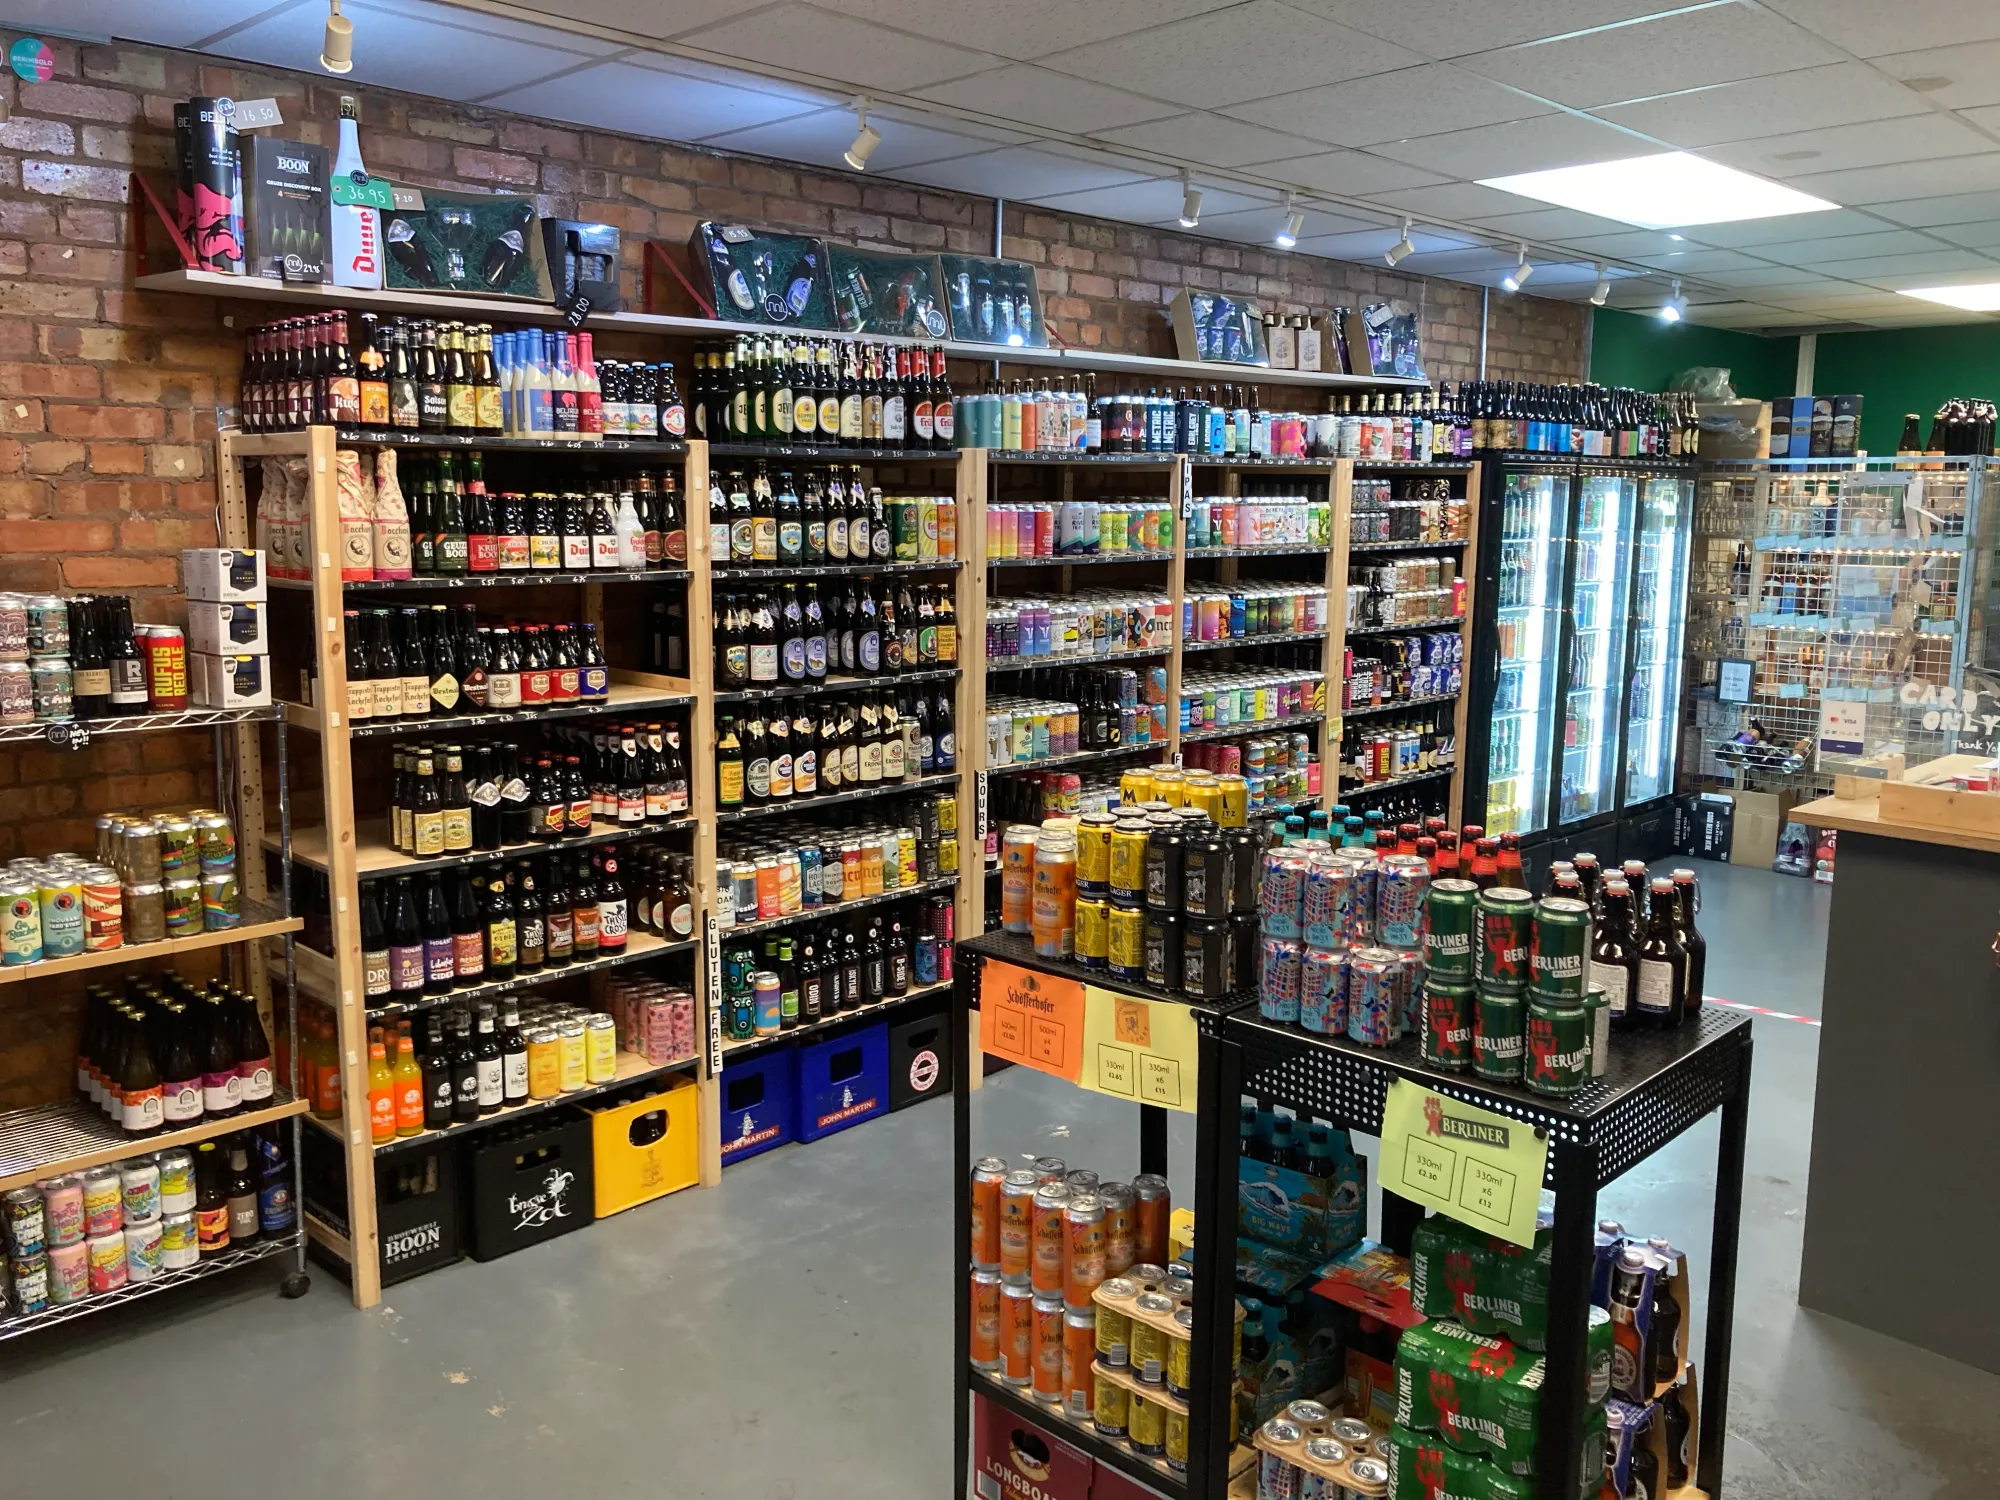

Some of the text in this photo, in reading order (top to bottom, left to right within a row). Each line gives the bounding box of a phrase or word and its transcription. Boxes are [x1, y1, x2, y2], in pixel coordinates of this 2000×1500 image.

[242, 107, 275, 122] 16.50
[277, 157, 310, 174] BOON
[266, 179, 283, 187] GEUZE
[284, 182, 310, 190] DISCOVERY
[349, 186, 386, 204] 36.95
[568, 297, 590, 327] 28.00
[1152, 410, 1161, 444] METRIC
[1162, 410, 1175, 444] METRIC
[127, 661, 141, 676] R
[154, 646, 171, 697] RUFUS
[173, 646, 187, 696] RED ALE
[1900, 682, 1978, 713] CARD
[1922, 710, 2000, 736] ONLY
[1953, 739, 1998, 753] Thank Yo
[1366, 749, 1374, 776] BITTER
[1380, 747, 1389, 774] RUFUS
[978, 773, 986, 836] SOURS
[605, 924, 627, 936] CROSS
[525, 936, 544, 948] CROSS
[1424, 933, 1469, 949] BERLINER
[460, 963, 484, 975] CIDER
[708, 918, 720, 1001] GLUTEN
[1532, 955, 1581, 970] BERLINER
[367, 967, 391, 983] DRY
[896, 957, 906, 983] B-SIDE
[368, 984, 391, 995] CIDER
[809, 984, 819, 1005] ODIN
[1007, 983, 1055, 1014] Schöfferhofer
[711, 1014, 719, 1067] FREE
[1039, 1026, 1056, 1037] 500ml
[1475, 1036, 1522, 1050] BERLINER
[1106, 1060, 1125, 1071] 330ml
[1149, 1063, 1170, 1074] 330ml
[1108, 1072, 1122, 1081] £2.65
[1155, 1087, 1166, 1095] £15
[821, 1100, 873, 1127] JOHN MARTIN
[744, 1128, 776, 1147] MARTIN
[1442, 1117, 1505, 1145] BERLINER
[1416, 1154, 1442, 1171] 330ml
[1418, 1168, 1438, 1181] £2.30
[1476, 1170, 1503, 1187] 330ml
[1482, 1187, 1493, 1197] x6
[1478, 1198, 1492, 1209] £12
[237, 1210, 254, 1220] ZERO
[513, 1200, 571, 1231] Zot
[1251, 1215, 1291, 1234] BIG WAVE
[385, 1226, 441, 1258] BOON
[1412, 1252, 1428, 1312] BERLINER
[1463, 1292, 1521, 1316] BERLINER
[1432, 1322, 1502, 1350] BERLINER
[1396, 1368, 1412, 1426] BERLINER
[1447, 1411, 1505, 1440] BERLINER
